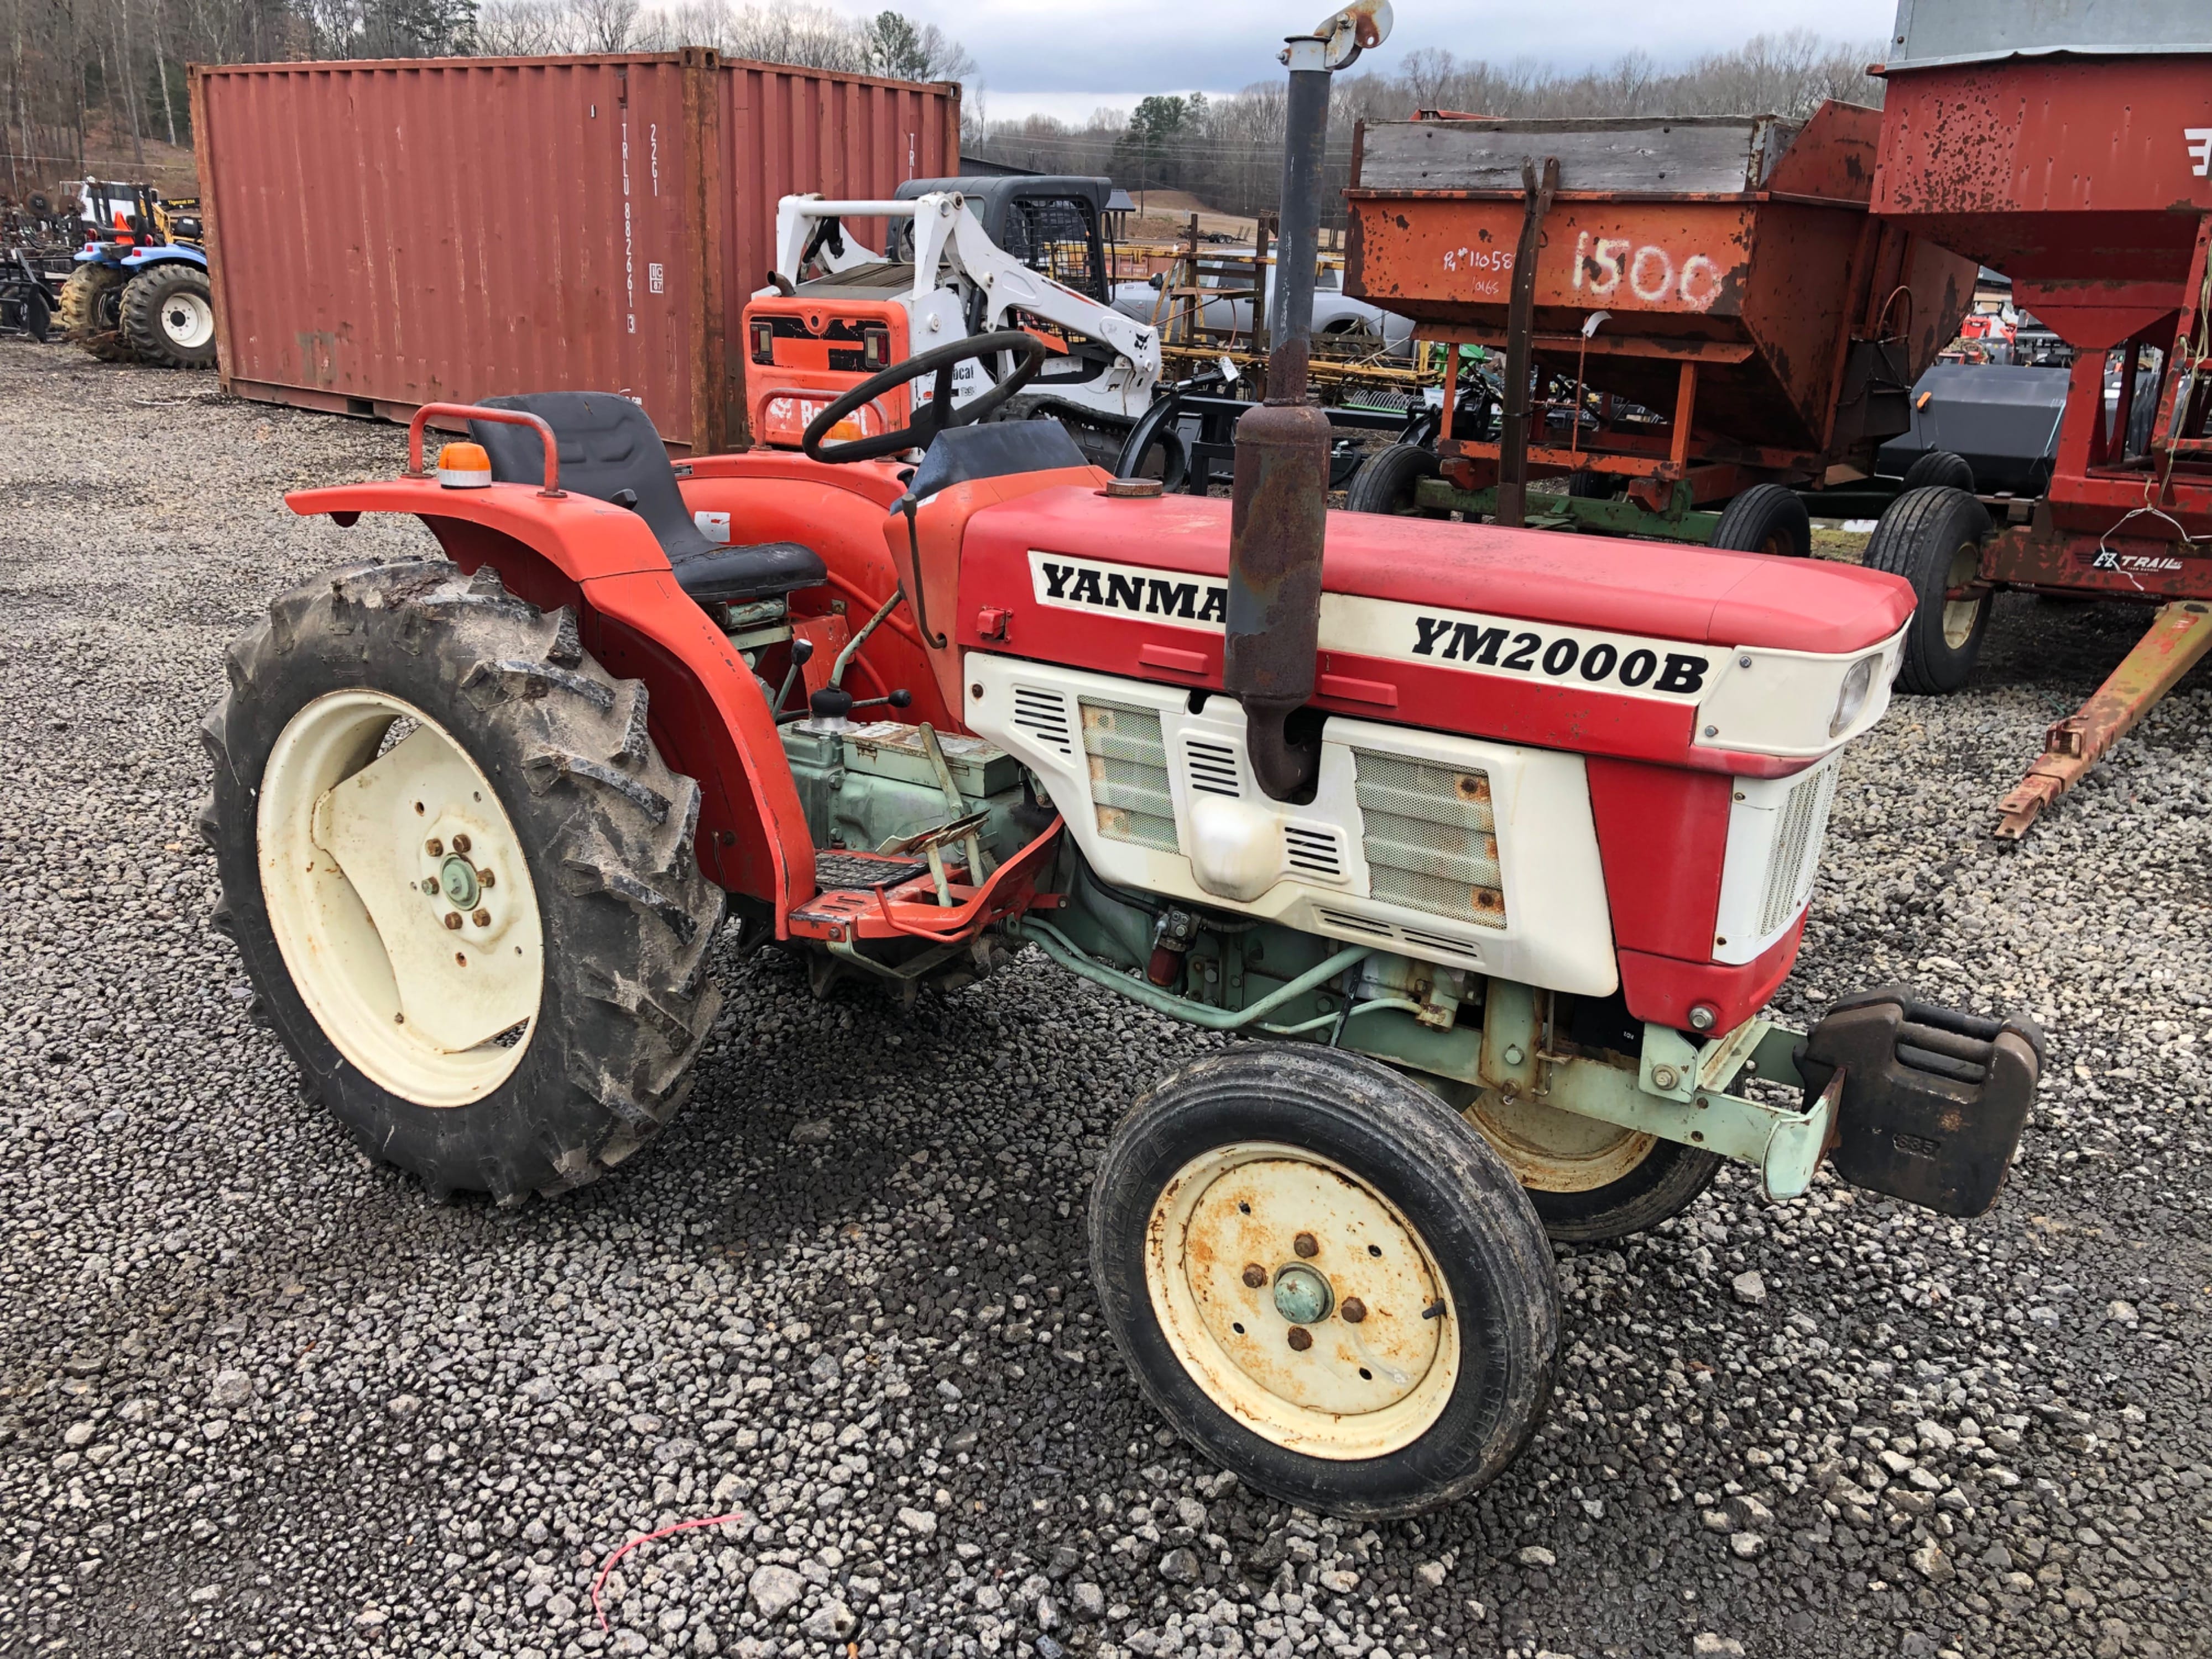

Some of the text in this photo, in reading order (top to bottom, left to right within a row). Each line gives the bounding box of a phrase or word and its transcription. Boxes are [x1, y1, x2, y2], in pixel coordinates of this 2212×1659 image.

[650, 123, 658, 197] 22G1
[624, 202, 633, 308] 882661
[1572, 230, 1723, 311] 1500
[1042, 562, 1228, 623] YANMA
[2121, 555, 2183, 570] TRAIL
[1412, 617, 1710, 693] YM2000B
